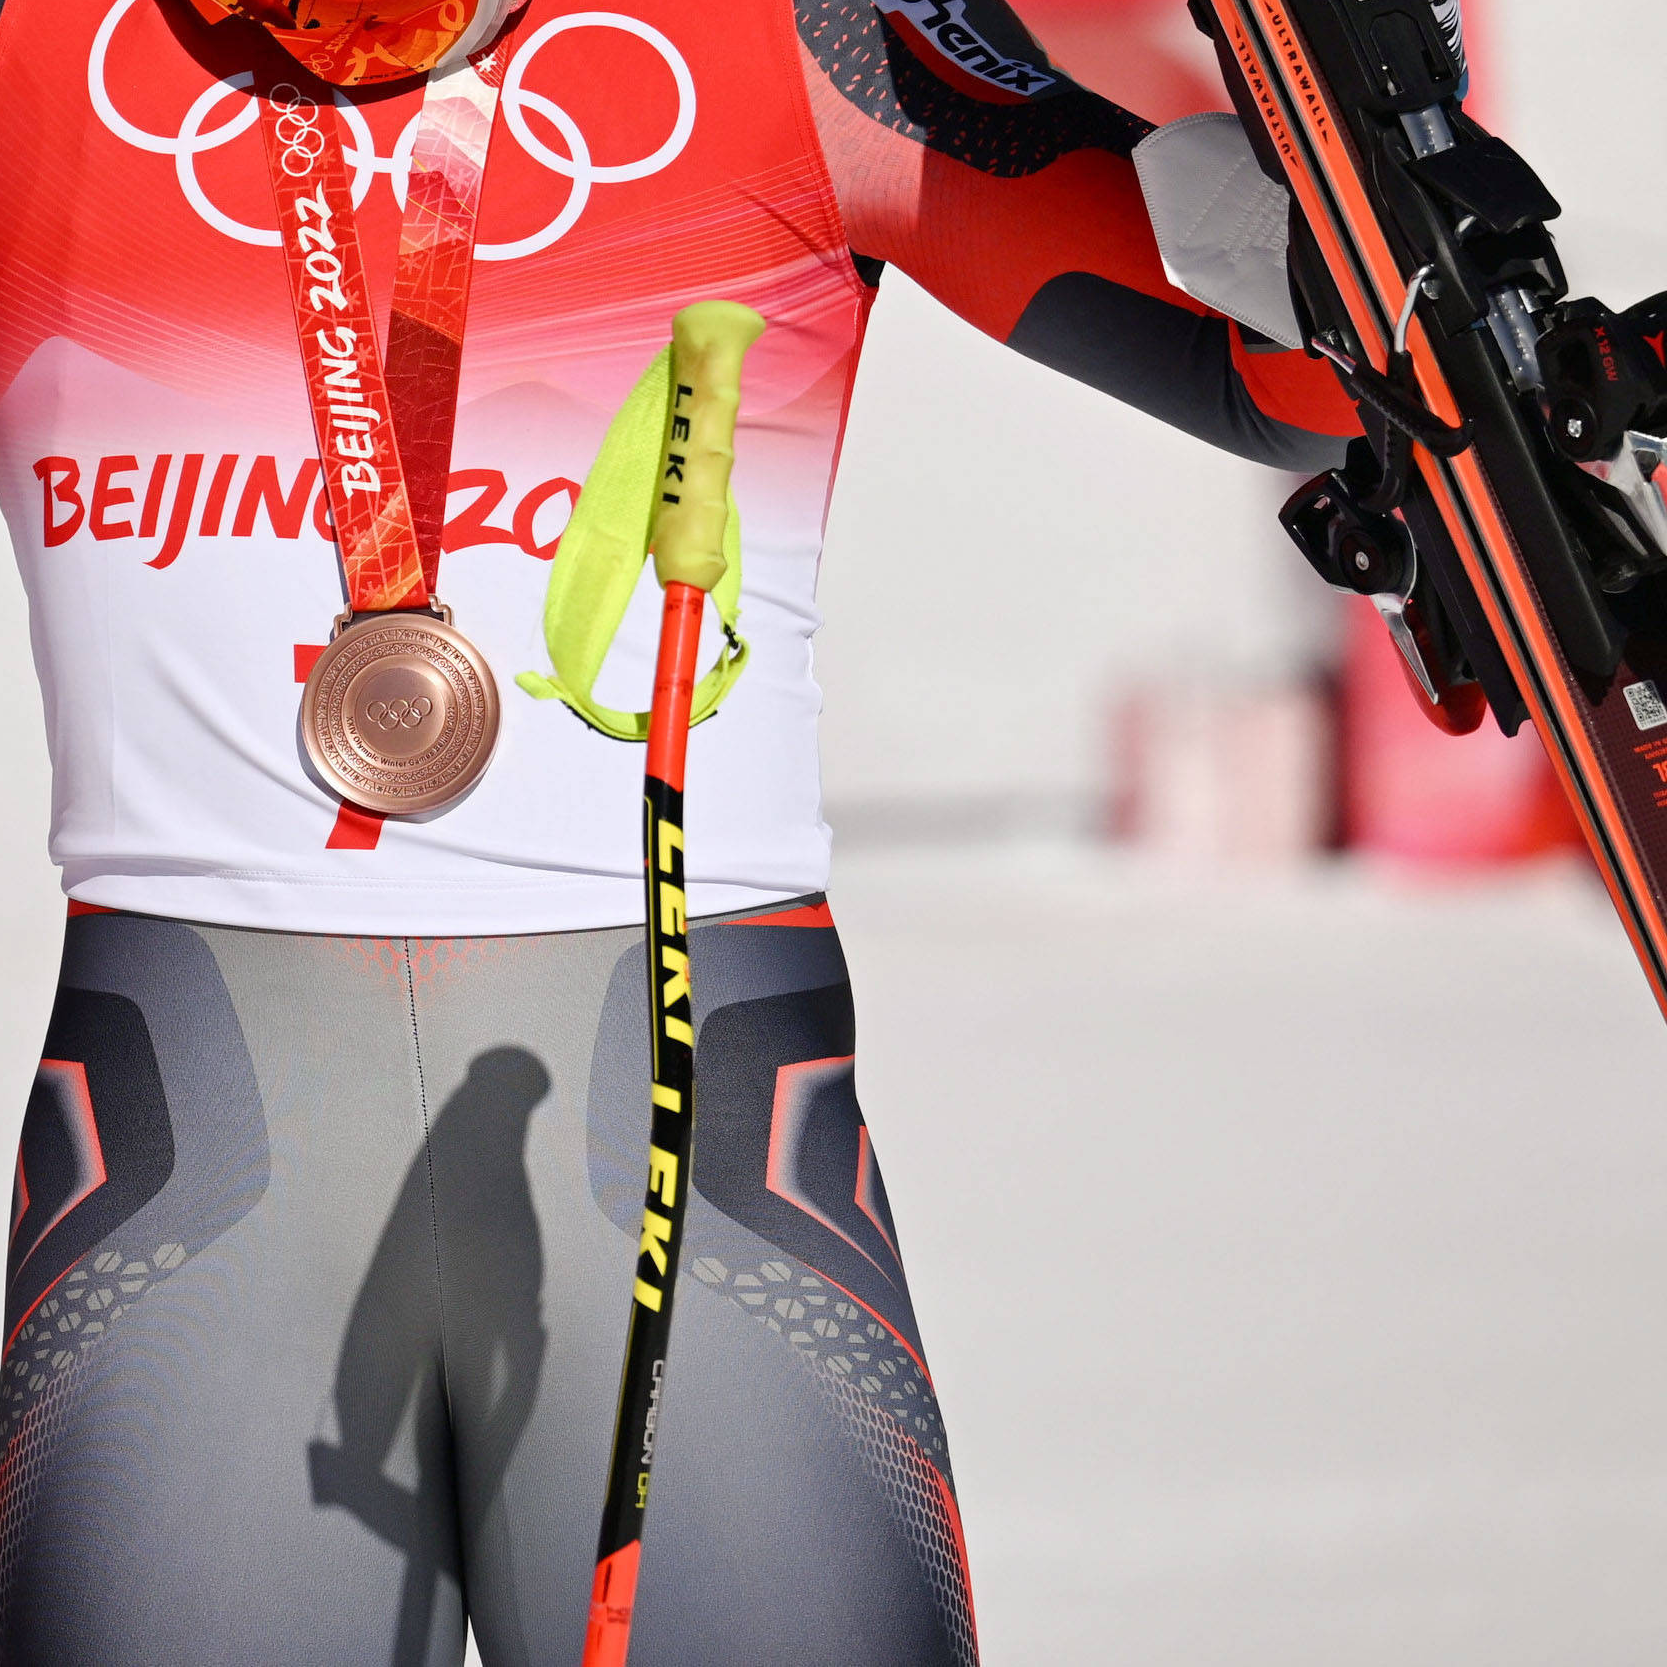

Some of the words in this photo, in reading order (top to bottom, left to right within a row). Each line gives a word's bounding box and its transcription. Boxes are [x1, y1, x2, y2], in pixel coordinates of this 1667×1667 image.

[1238, 42, 1291, 154] ULTRAWALL
[1272, 15, 1325, 128] ULTRAWALL
[295, 183, 351, 313] 2022
[323, 327, 380, 501] BEIJING
[661, 384, 694, 506] LEKI
[346, 716, 355, 735] XXIV
[353, 737, 378, 762] Olympic
[380, 758, 407, 767] Winter
[649, 817, 693, 1051] LEKI
